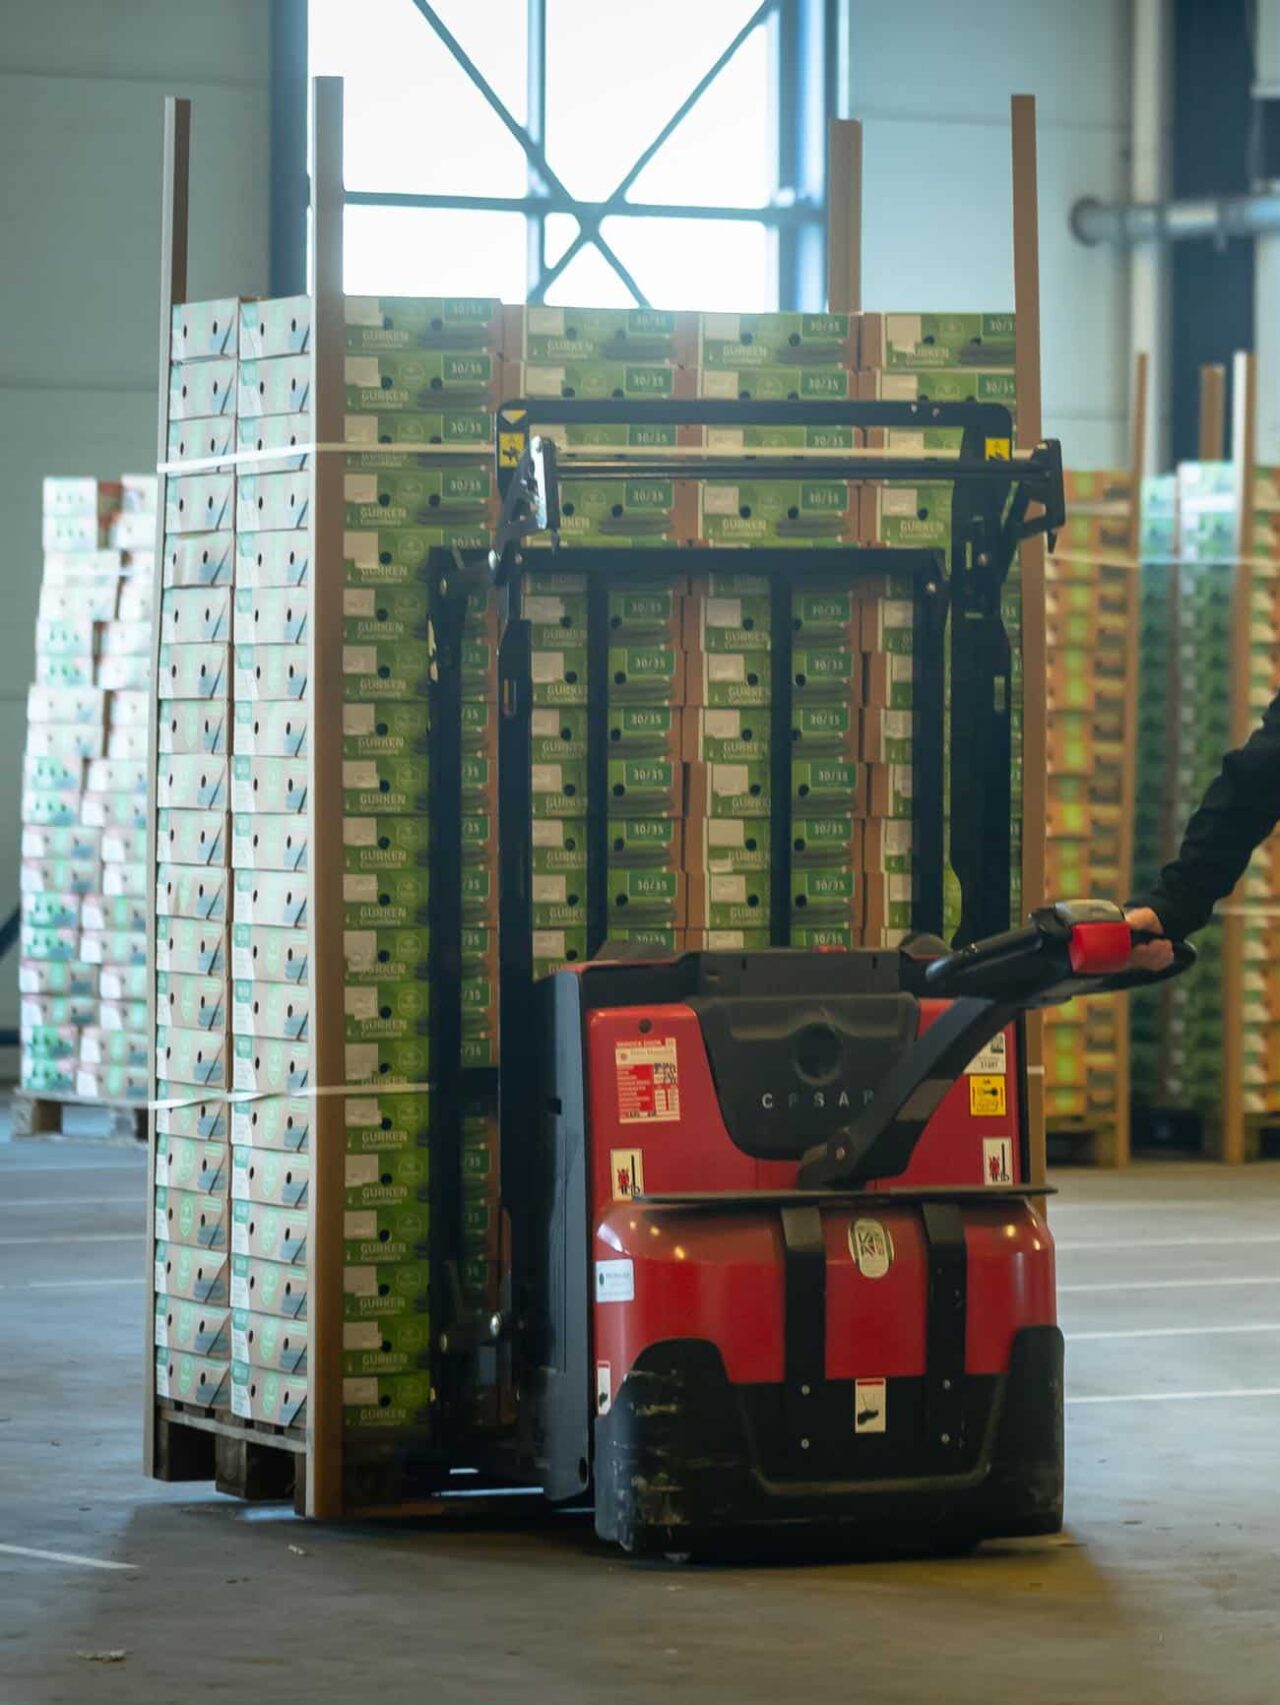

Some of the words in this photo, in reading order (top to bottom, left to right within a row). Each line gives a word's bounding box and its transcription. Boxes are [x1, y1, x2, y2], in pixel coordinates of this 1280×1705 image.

[989, 320, 1015, 332] 30/3
[451, 422, 482, 434] 30/35
[361, 508, 407, 519] GURKEN
[561, 517, 590, 530] RKEN
[636, 658, 665, 669] 30/35
[632, 714, 661, 725] 30/35
[811, 715, 840, 725] 30/35
[634, 769, 663, 781] 30/35
[360, 794, 406, 804] GURKEN
[635, 824, 664, 834] 30/35
[815, 824, 843, 835] 30/35
[360, 851, 406, 861] GURKEN
[638, 880, 667, 891] 30/35
[816, 880, 845, 890] 30/35
[360, 907, 406, 918] GURKEN
[361, 1131, 407, 1142] GURKEN
[362, 1187, 408, 1198] GURKEN
[360, 1243, 406, 1254] GURKEN
[360, 1297, 405, 1308] GURKEN
[362, 1354, 408, 1365] GURKEN
[360, 1409, 406, 1419] GURKEN
